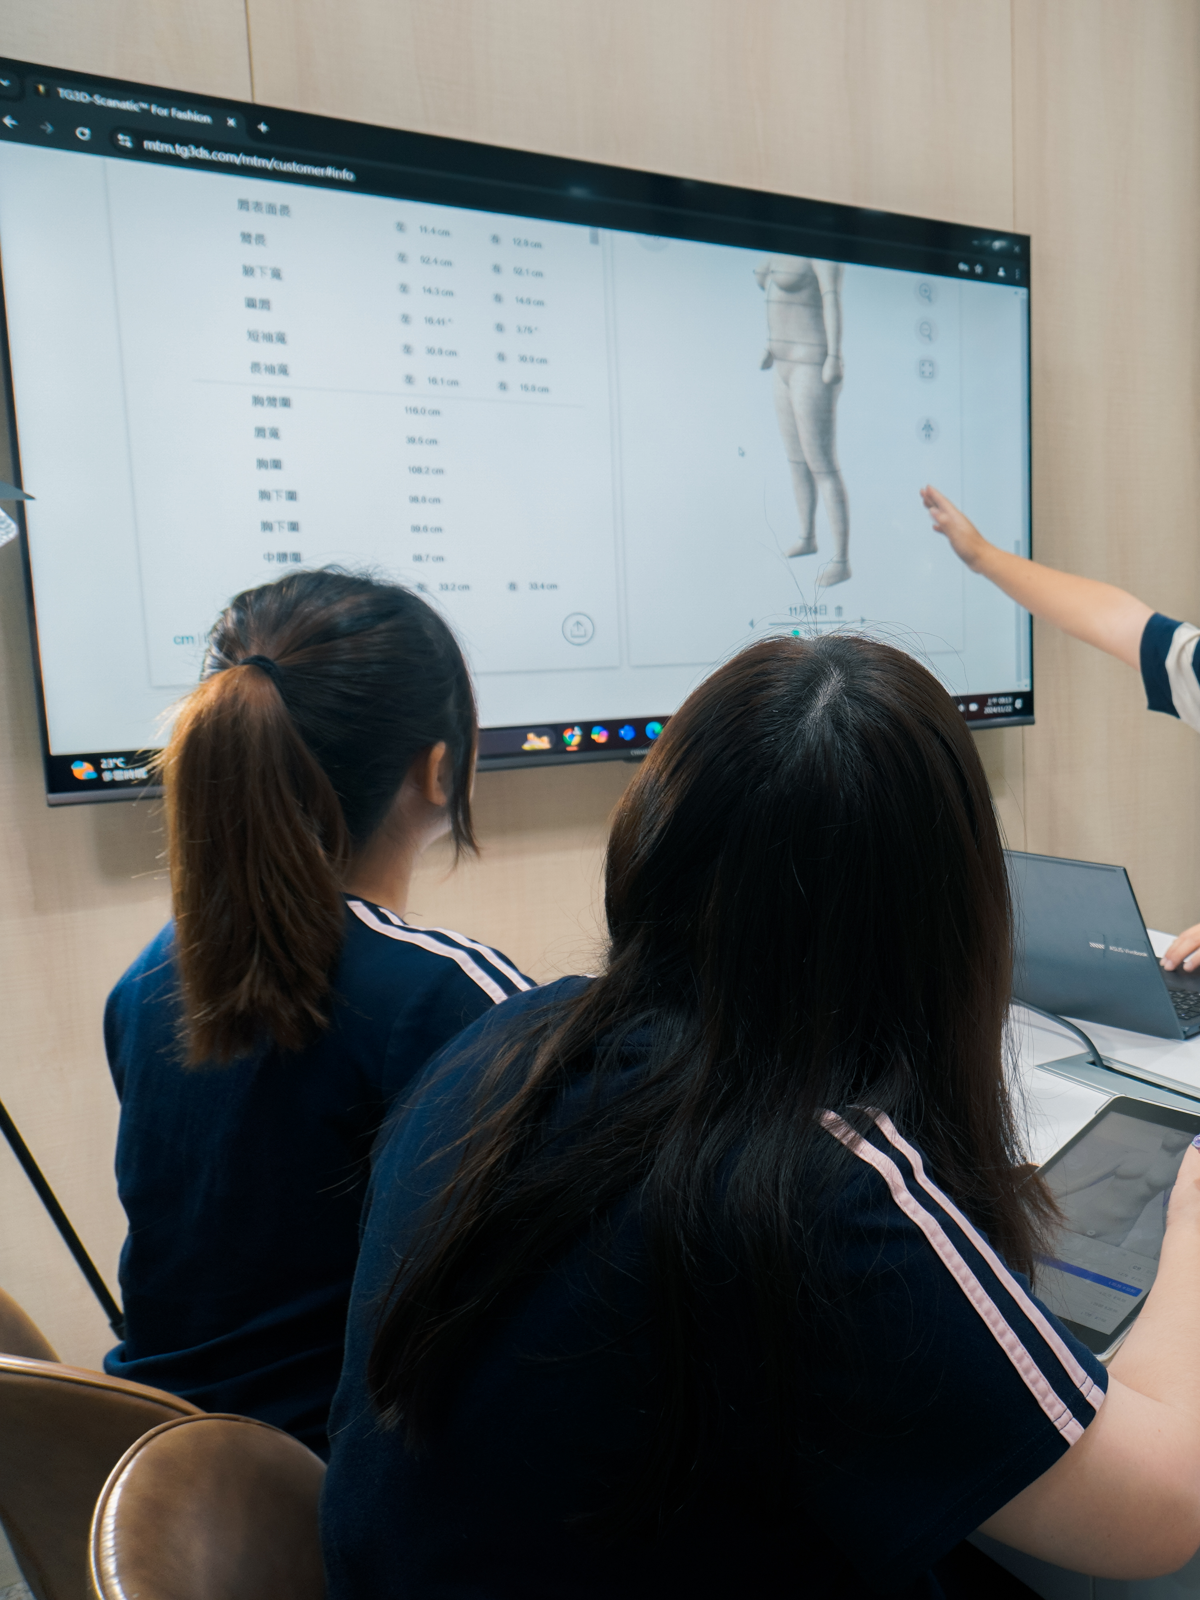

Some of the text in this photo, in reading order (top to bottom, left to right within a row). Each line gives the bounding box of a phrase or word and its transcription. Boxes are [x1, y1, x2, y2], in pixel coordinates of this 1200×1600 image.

[151, 104, 169, 116] For
[171, 106, 212, 124] Fashion
[143, 139, 356, 181] mtm.tg3ds.com/mtm/customer#info
[438, 229, 450, 237] cm
[530, 241, 542, 249] cm
[439, 259, 452, 267] cm
[531, 270, 543, 278] cm
[441, 289, 454, 297] cm
[532, 298, 545, 307] cm
[444, 349, 457, 357] cm
[535, 356, 548, 365] cm
[446, 379, 459, 387] cm
[537, 386, 549, 394] cm
[425, 438, 437, 446] cm
[431, 467, 444, 475] cm
[429, 526, 442, 534] cm
[431, 555, 444, 563] cm
[548, 583, 558, 591] cm
[173, 634, 194, 645] cm
